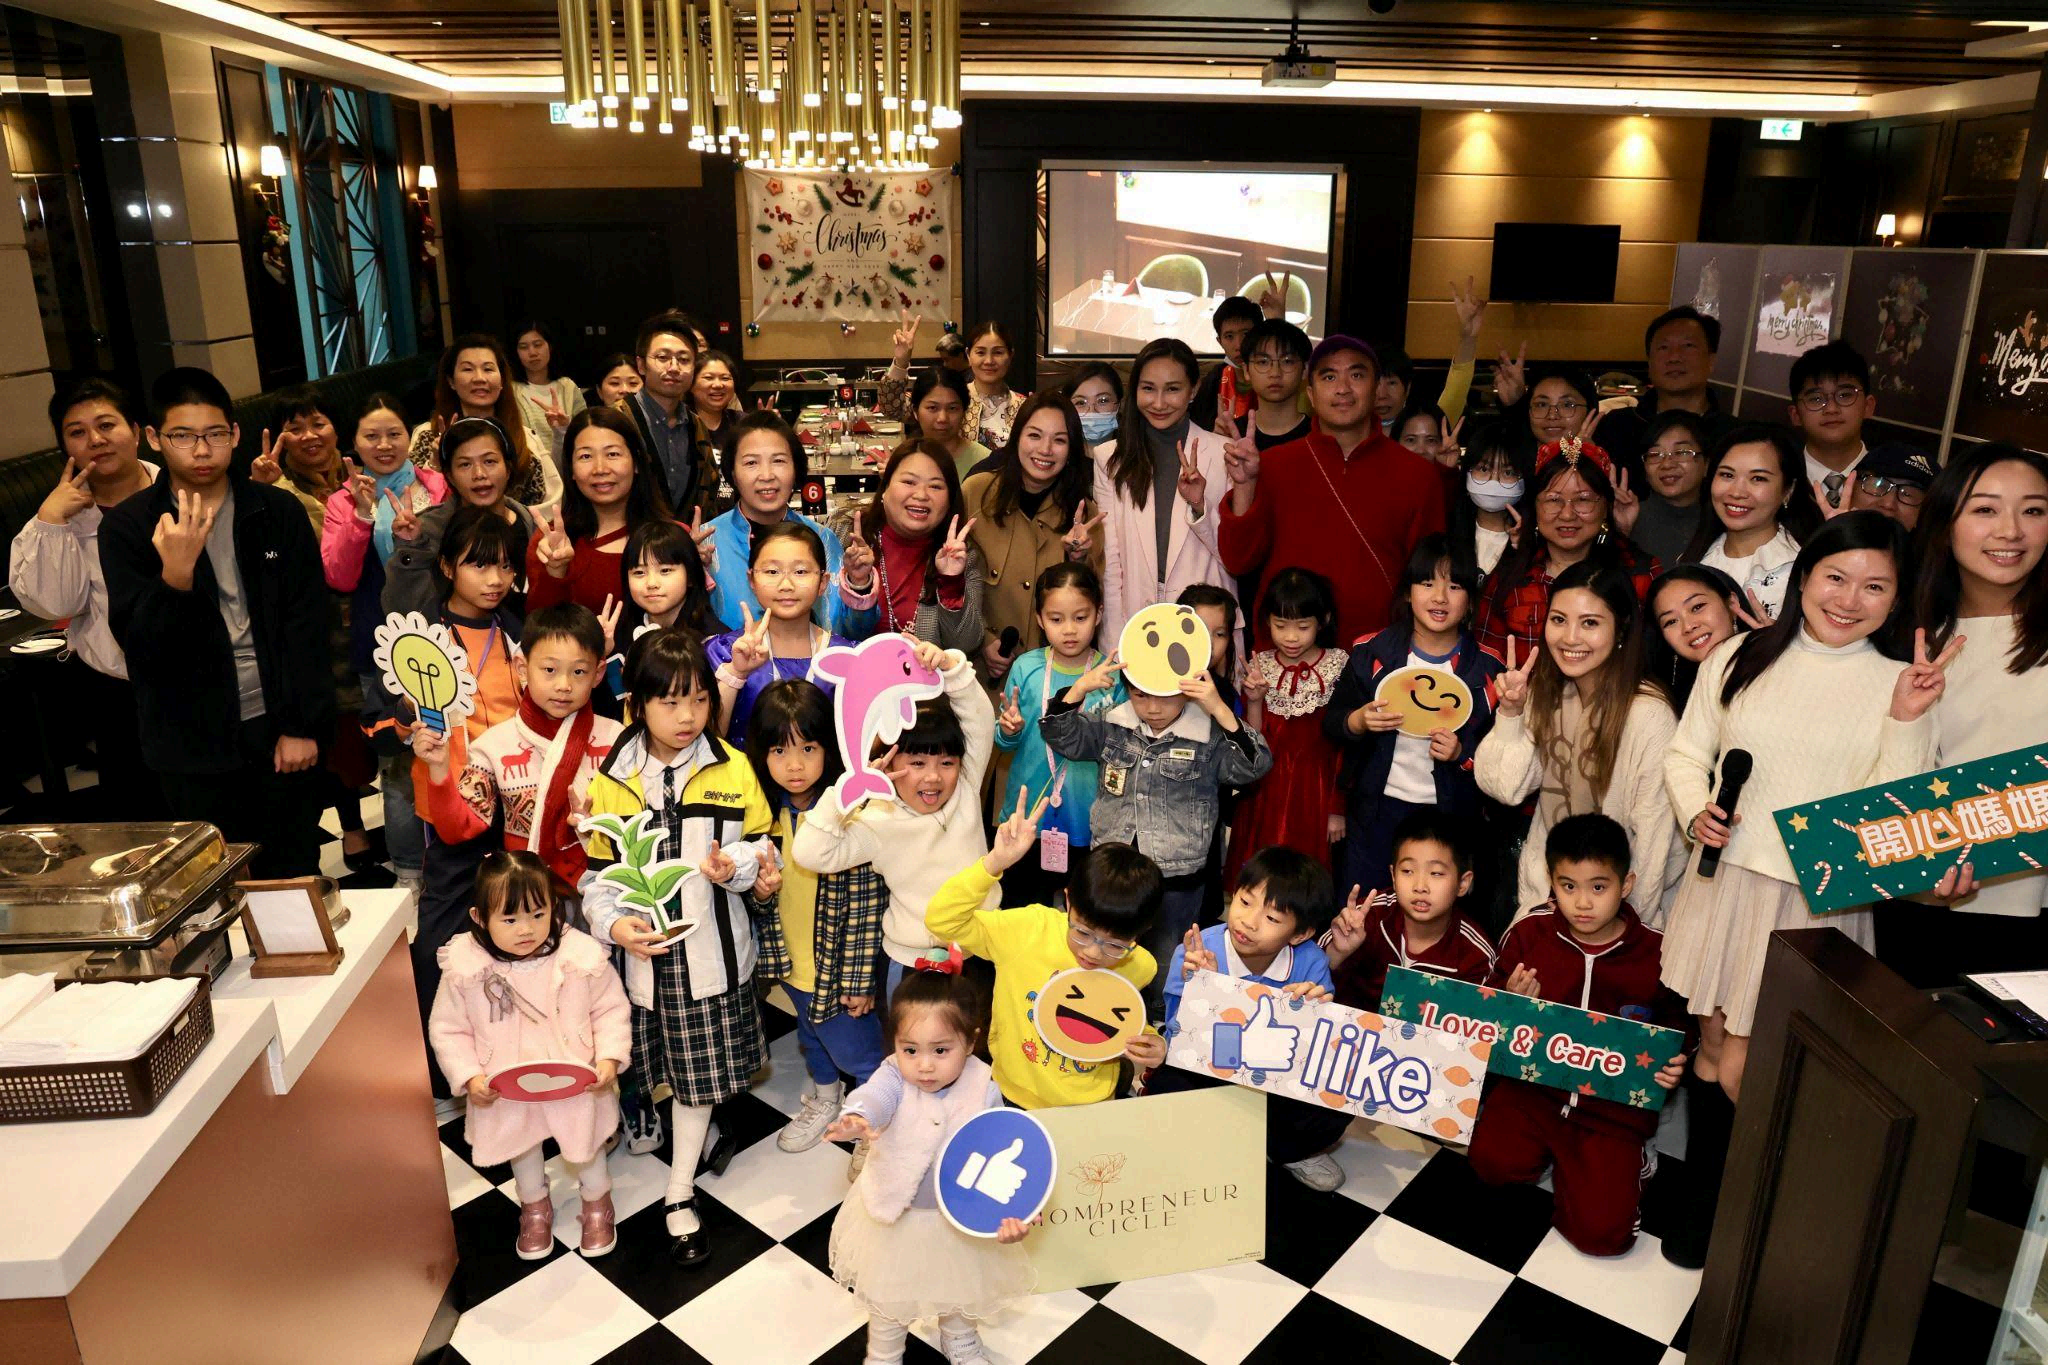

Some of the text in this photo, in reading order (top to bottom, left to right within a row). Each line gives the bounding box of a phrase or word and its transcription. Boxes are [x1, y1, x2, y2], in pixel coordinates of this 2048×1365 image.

[806, 213, 893, 258] Christmas
[1766, 314, 1790, 340] Merry
[843, 390, 851, 398] 5
[1904, 459, 1934, 476] adidas
[808, 485, 816, 499] 6
[1860, 784, 2048, 863] 開心媽媽
[1423, 1004, 1624, 1074] Love & Care
[1300, 1017, 1431, 1114] like
[1089, 1210, 1177, 1237] CICLE
